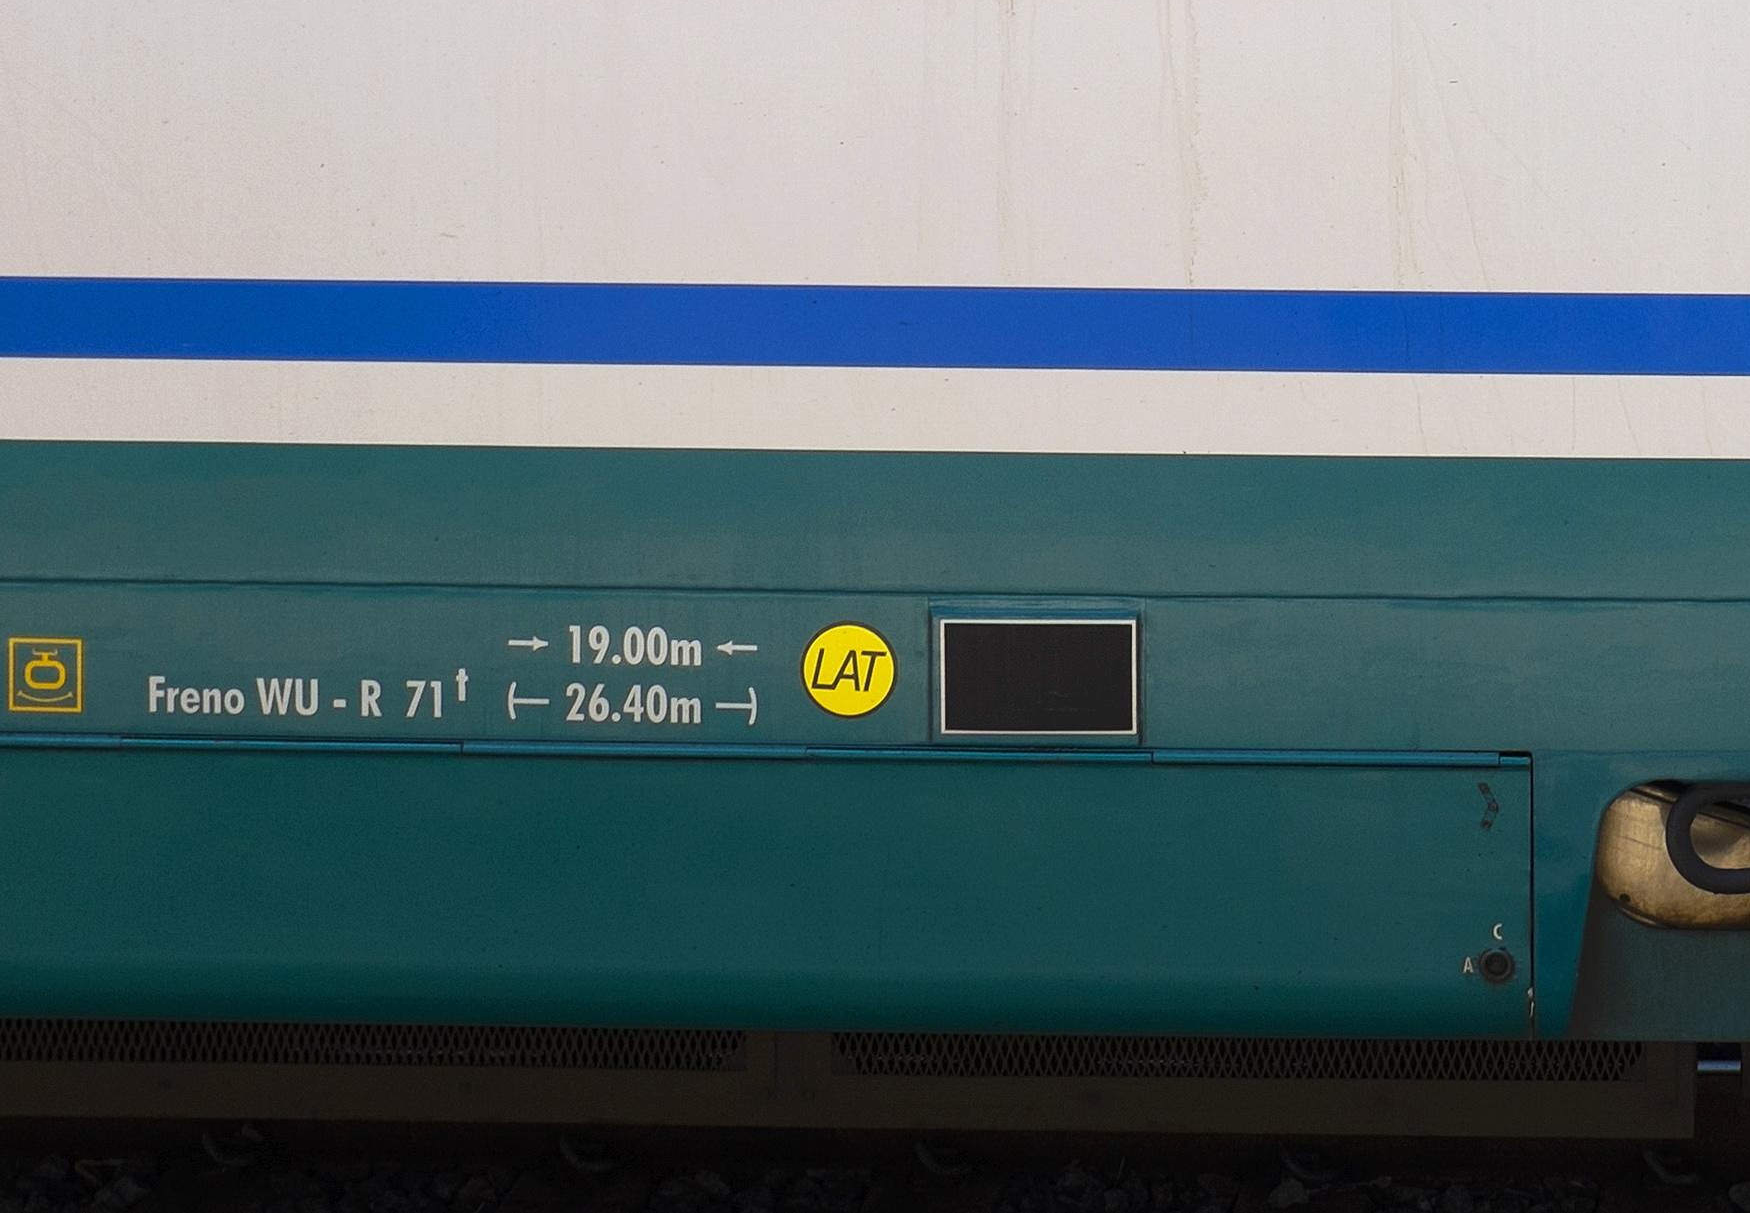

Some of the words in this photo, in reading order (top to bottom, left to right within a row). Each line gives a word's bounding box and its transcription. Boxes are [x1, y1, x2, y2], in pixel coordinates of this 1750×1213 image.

[568, 624, 702, 667] 19.00m
[811, 647, 888, 692] LAT
[148, 675, 245, 715] Freno
[256, 677, 319, 716] WU
[361, 679, 382, 717] R
[565, 682, 702, 724] 26.40m
[1493, 923, 1503, 940] C
[1463, 956, 1474, 973] A
